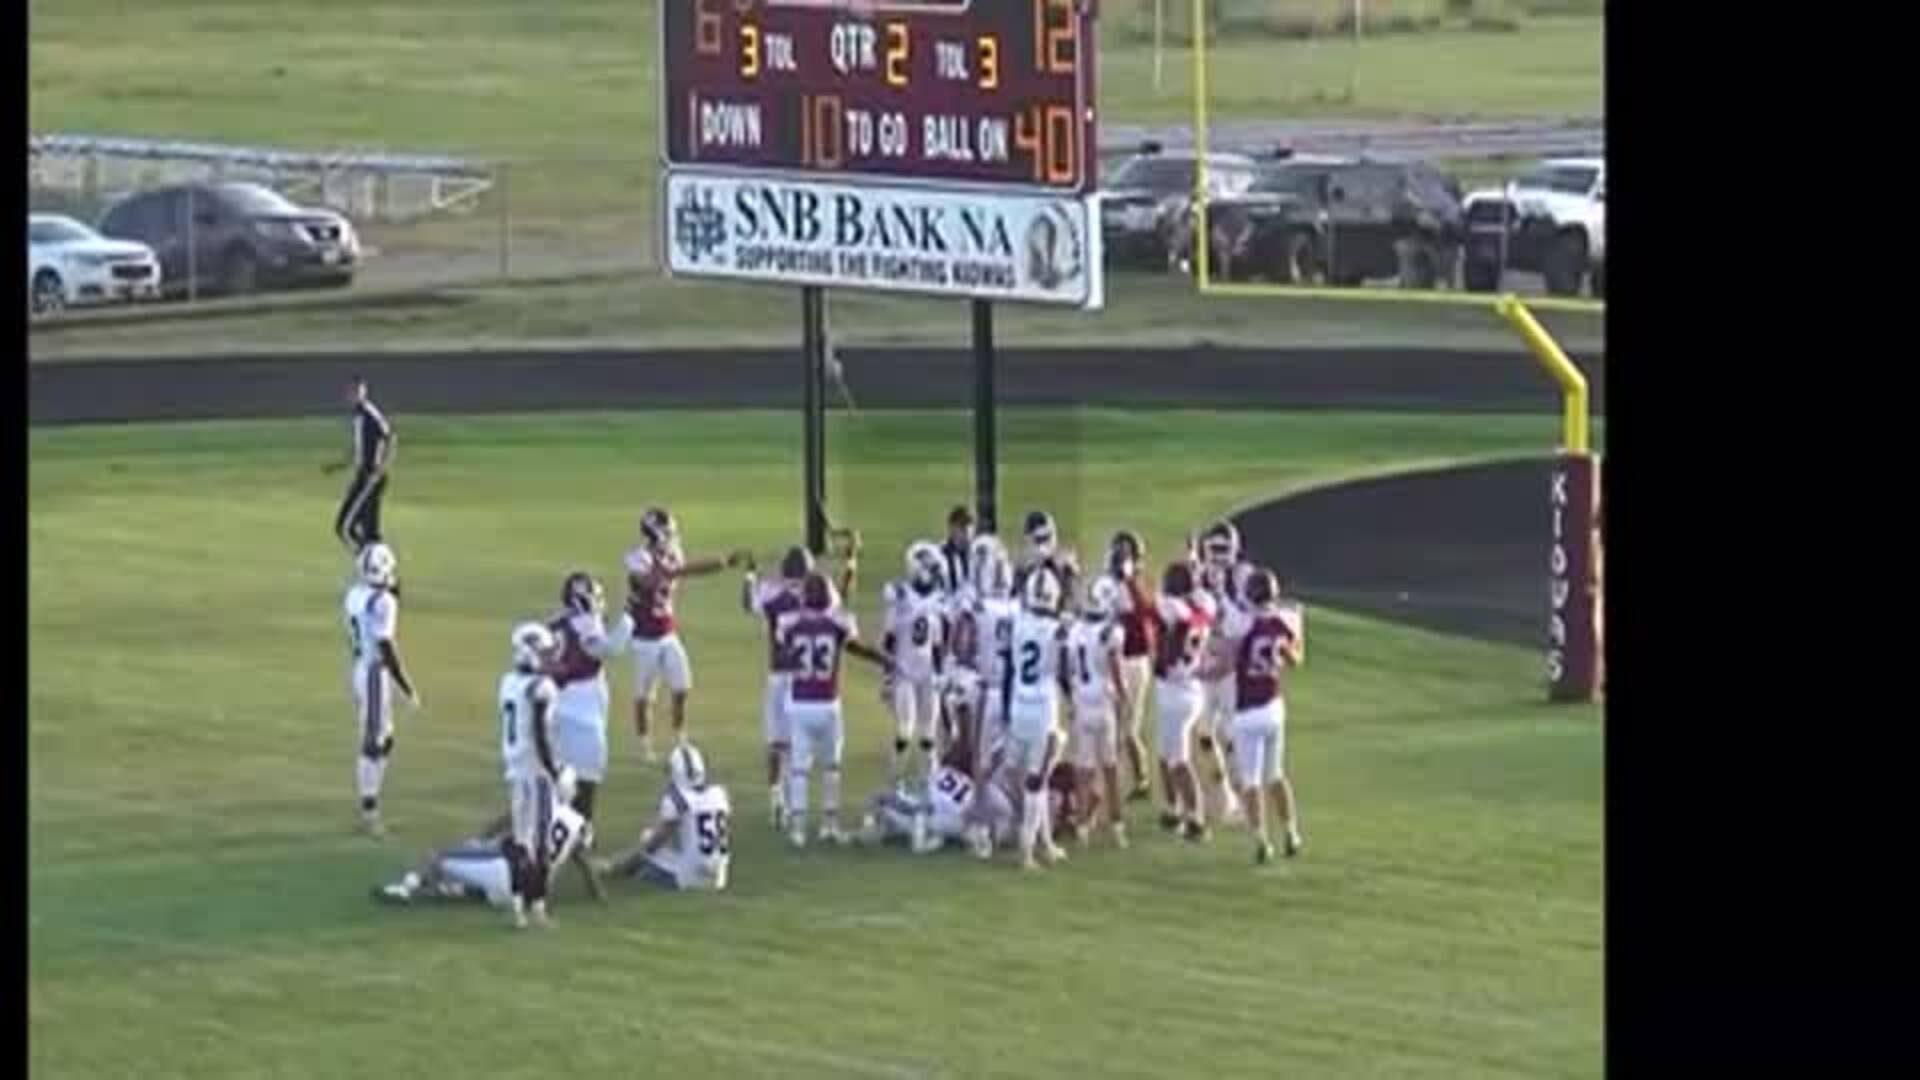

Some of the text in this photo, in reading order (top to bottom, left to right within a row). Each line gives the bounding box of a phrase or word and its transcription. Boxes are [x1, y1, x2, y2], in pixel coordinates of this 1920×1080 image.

[740, 25, 759, 77] 3
[830, 22, 909, 85] QTR 2
[977, 36, 999, 89] 3
[702, 101, 762, 146] DOWN
[802, 95, 843, 169] 10
[846, 109, 874, 157] TO
[923, 104, 1074, 183] BALL ON 40
[735, 184, 822, 243] SNB
[959, 207, 1013, 256] NA
[838, 252, 867, 280] THE
[792, 635, 836, 679] 33
[1020, 640, 1041, 685] 2
